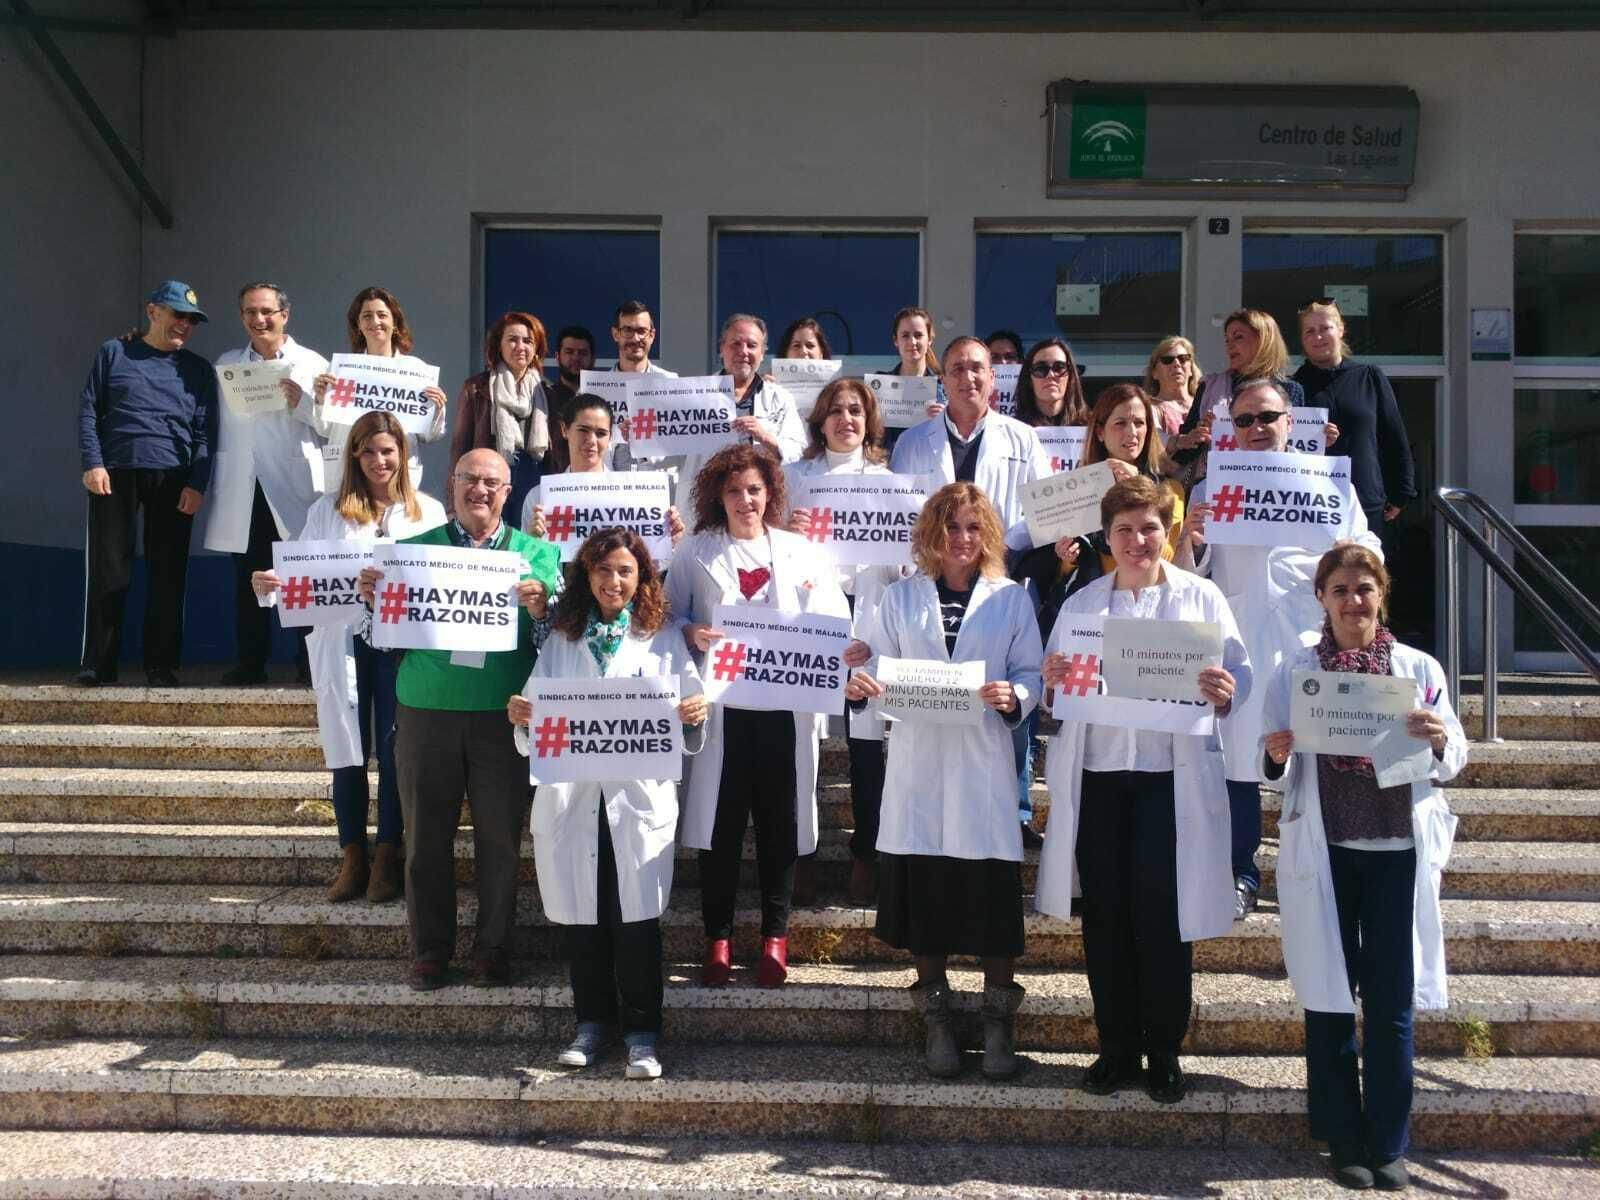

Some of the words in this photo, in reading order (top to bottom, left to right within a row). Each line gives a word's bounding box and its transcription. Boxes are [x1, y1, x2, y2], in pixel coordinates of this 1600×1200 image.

[1258, 122, 1317, 145] Centro
[1323, 125, 1345, 146] de
[1351, 125, 1403, 148] Salud
[1214, 220, 1224, 233] 2
[354, 397, 428, 416] RAZONES
[658, 422, 731, 437] RAZONES
[1243, 507, 1342, 525] RAZONES
[833, 528, 913, 543] RAZONE
[407, 607, 509, 626] RAZONES
[722, 620, 766, 630] SINDICATO
[802, 627, 813, 635] DE
[1121, 648, 1134, 659] 10
[1137, 649, 1182, 661] minutos
[1184, 651, 1204, 663] por
[744, 667, 839, 690] RAZONES
[1137, 665, 1185, 677] paciente
[538, 693, 585, 701] SINDICATO
[885, 684, 937, 697] MINUTOS
[941, 687, 970, 698] PARA
[884, 698, 905, 708] MIS
[908, 698, 970, 711] PACIENTES
[1310, 707, 1324, 719] 10
[1327, 709, 1374, 721] minutos
[1376, 712, 1396, 724] por
[1328, 724, 1377, 737] paciente
[570, 738, 673, 754] RAZONES
